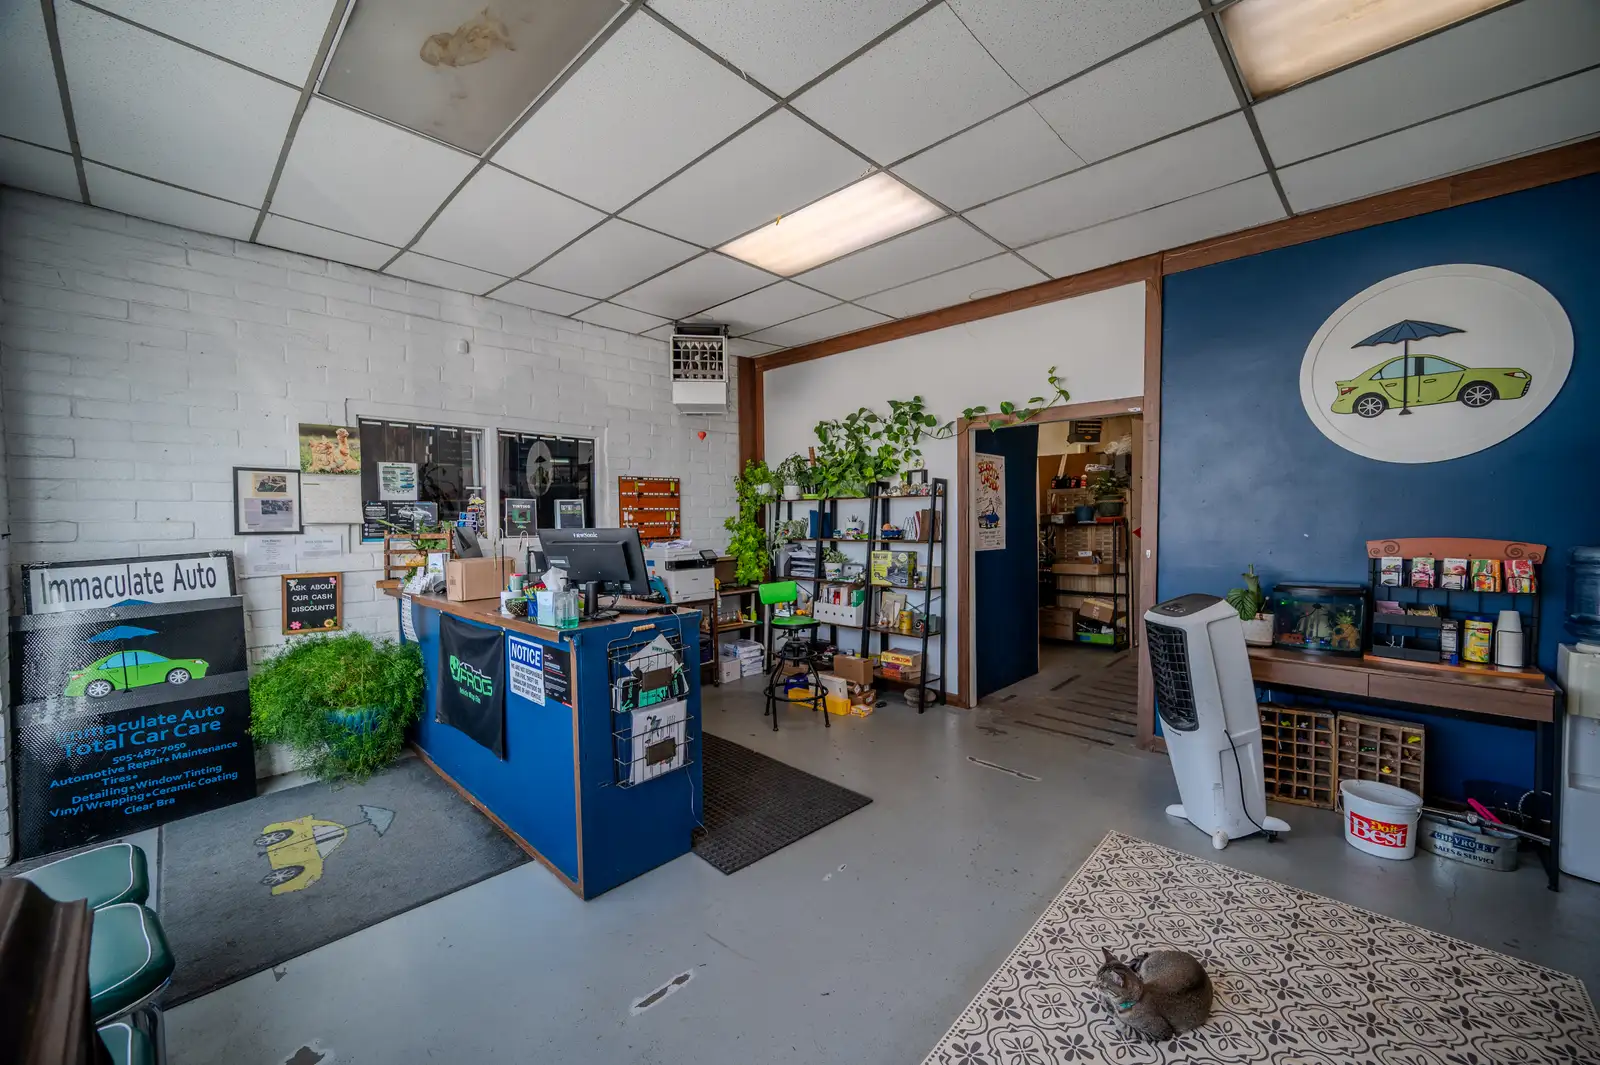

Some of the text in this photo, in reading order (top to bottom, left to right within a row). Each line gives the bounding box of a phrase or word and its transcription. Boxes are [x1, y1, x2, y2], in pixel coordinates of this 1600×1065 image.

[40, 562, 217, 604] Immaculate Auto
[291, 603, 335, 612] DISCOUNTS
[511, 642, 540, 667] NOTICE
[460, 667, 492, 696] FROG
[55, 705, 225, 743] Immaculate Auto
[63, 719, 221, 759] Total Car Care
[50, 766, 125, 789] Automotive
[172, 740, 238, 761] Maintenance
[112, 742, 186, 764] 505-487-7050
[136, 773, 182, 789] Window
[184, 765, 223, 779] Tinting
[50, 771, 239, 818] Vinyl Wrapping Ceramic Coating
[124, 797, 175, 815] Clear Bra
[1351, 816, 1405, 847] Best
[1434, 832, 1495, 853] CHEVROLET
[1434, 844, 1456, 855] SALES
[1464, 852, 1494, 864] SERVICE
